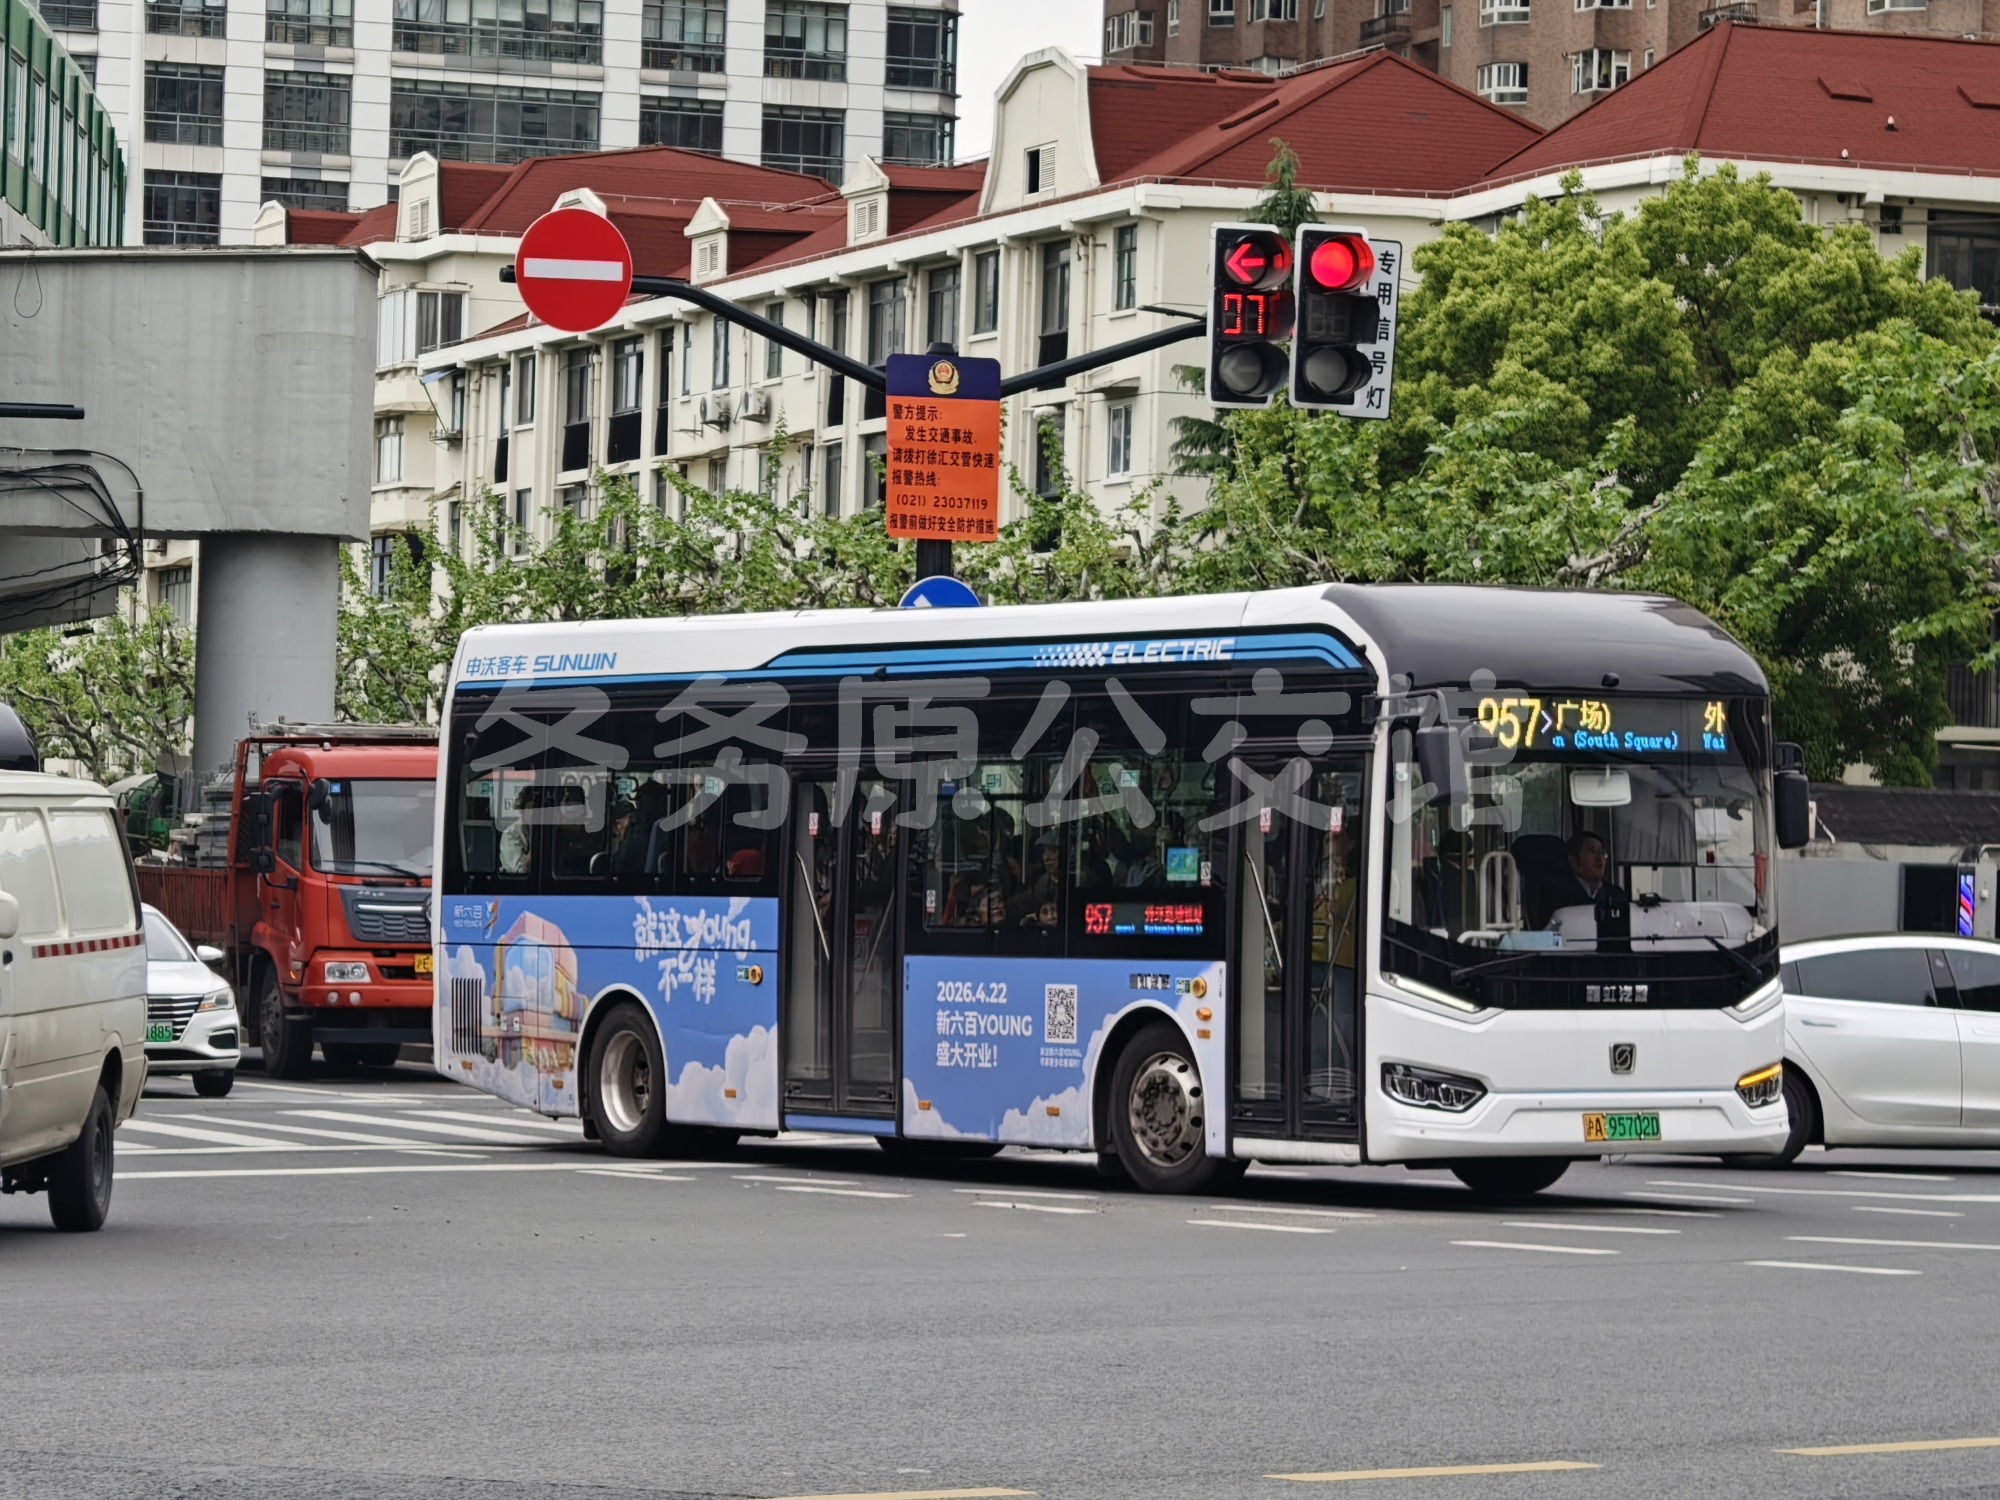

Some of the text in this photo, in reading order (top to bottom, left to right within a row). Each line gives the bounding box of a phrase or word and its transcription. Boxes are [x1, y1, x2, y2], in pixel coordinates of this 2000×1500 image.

[1366, 251, 1396, 409] 专用信号灯
[892, 447, 995, 469] 请拨打徐汇交管快速
[896, 493, 988, 510] (021) 23037119
[889, 512, 995, 534] 报警前做好安全防护措施
[1110, 638, 1236, 664] ELECTRIC
[466, 652, 618, 677] 申沃客车 SUNWIN
[1477, 698, 1541, 748] 957
[1574, 730, 1619, 750] (South
[1624, 731, 1678, 752] Square)
[1085, 903, 1113, 934] 957
[936, 981, 1008, 1004] 2026.4.22
[936, 1009, 1033, 1037] 新六百YOUNG
[936, 1041, 998, 1068] 盛大开业!
